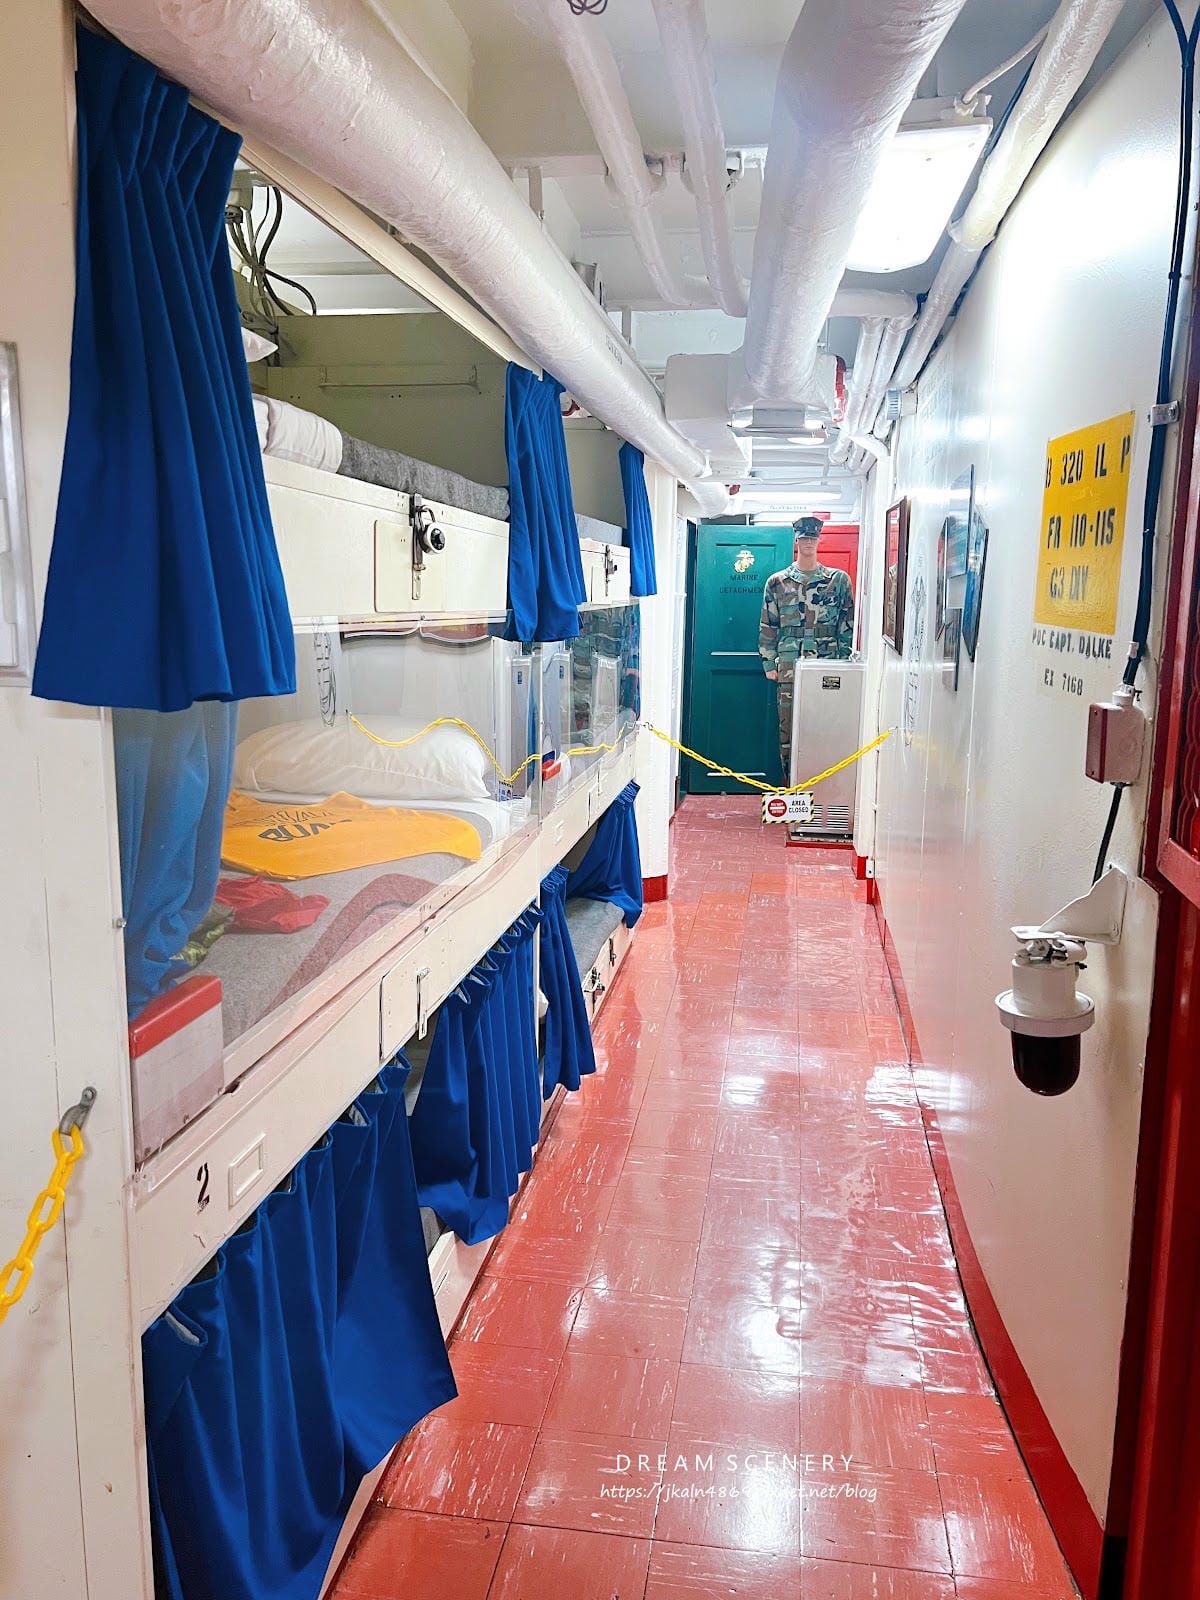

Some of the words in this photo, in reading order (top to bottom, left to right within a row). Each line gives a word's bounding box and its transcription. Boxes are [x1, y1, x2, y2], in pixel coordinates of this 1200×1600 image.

[1060, 449, 1084, 485] 320
[1094, 441, 1108, 478] IL
[1047, 515, 1062, 550] FR
[1049, 566, 1066, 602] G3
[1032, 628, 1047, 648] POC
[1078, 635, 1113, 660] DALKE
[1044, 671, 1055, 688] EX
[1062, 672, 1084, 696] 7168
[196, 1162, 210, 1214] 2
